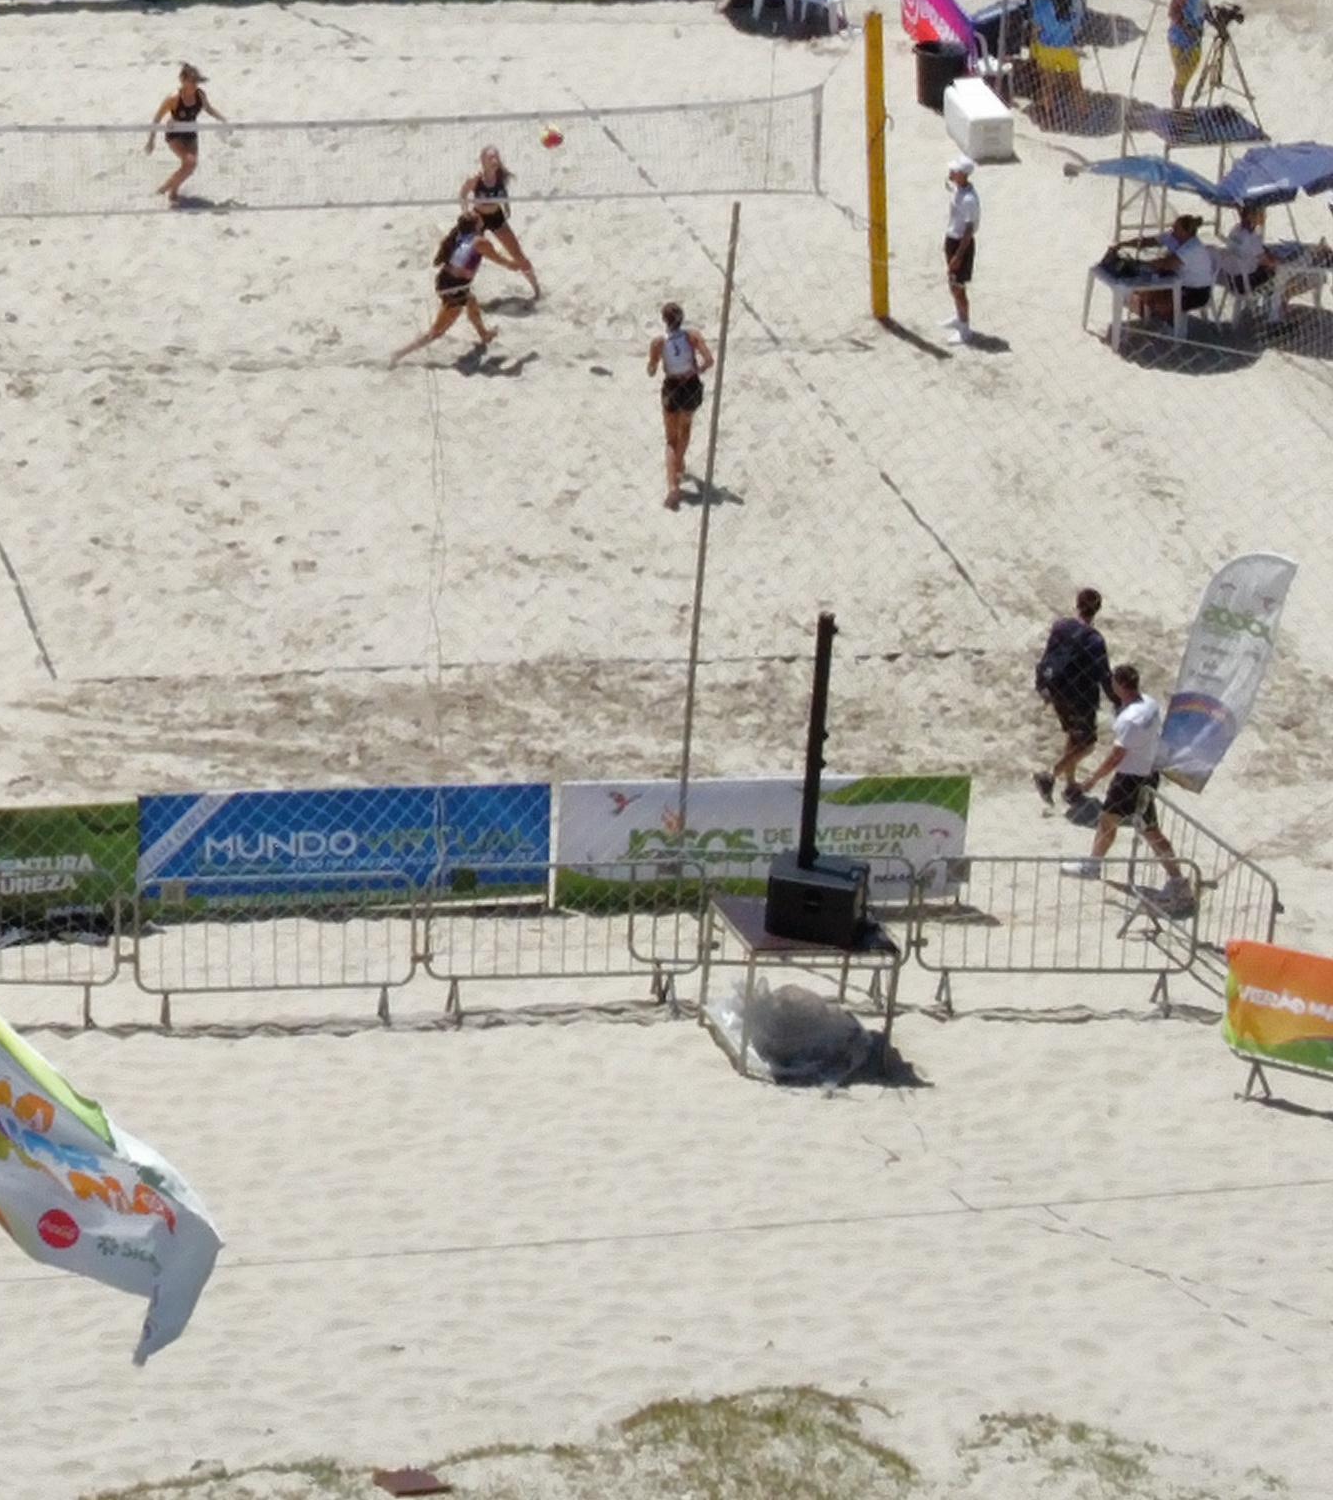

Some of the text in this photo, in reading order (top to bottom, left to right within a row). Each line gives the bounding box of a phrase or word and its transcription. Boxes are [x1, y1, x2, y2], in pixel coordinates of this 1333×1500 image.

[205, 830, 358, 861] MUNDO
[762, 829, 793, 844] DE
[815, 822, 923, 843] VENTURA
